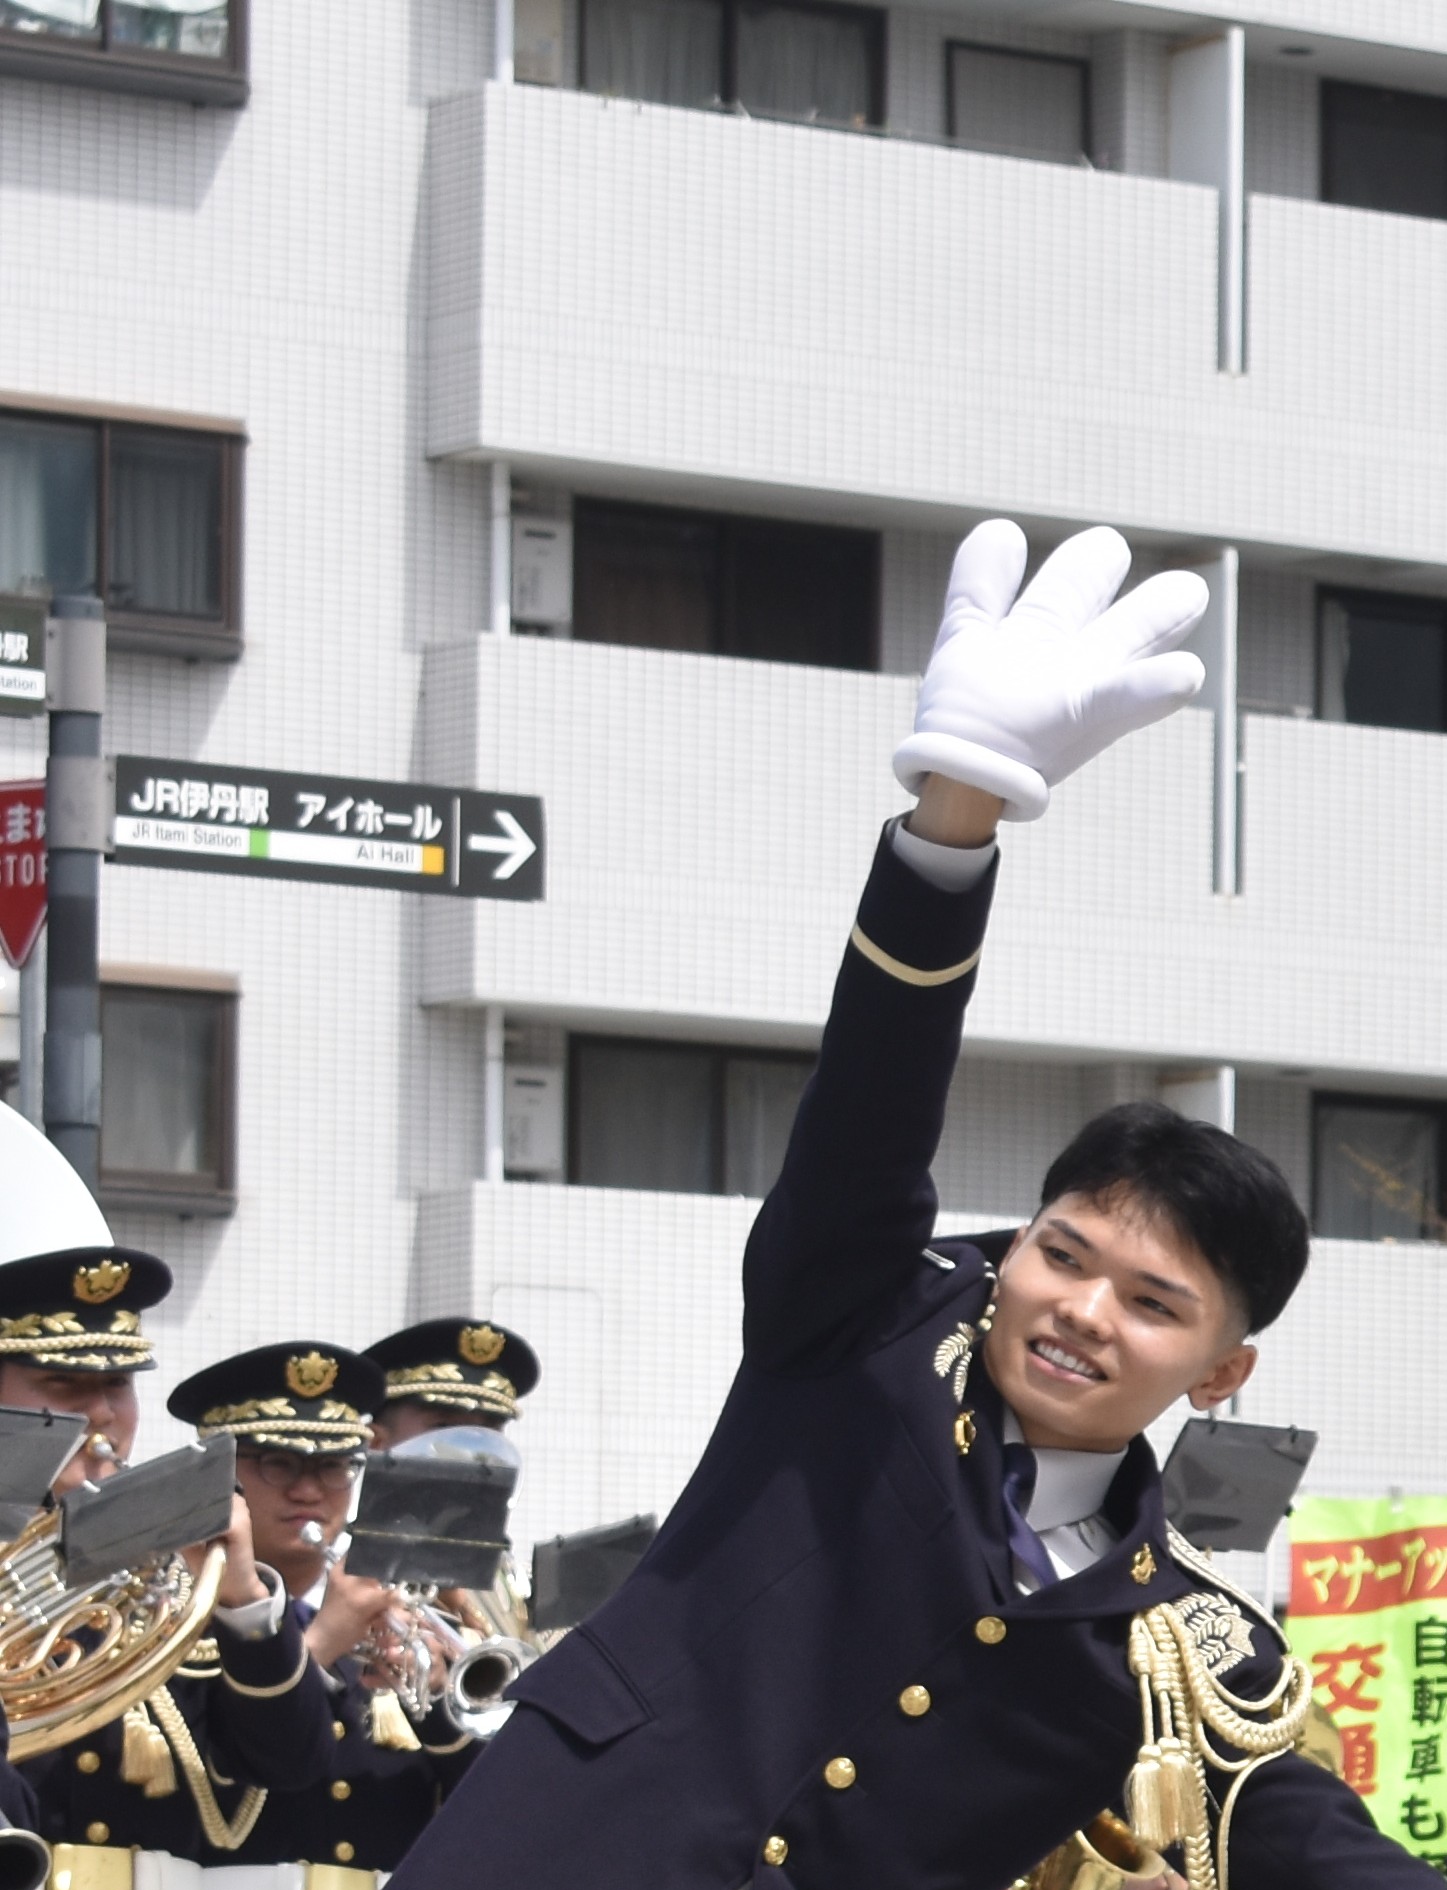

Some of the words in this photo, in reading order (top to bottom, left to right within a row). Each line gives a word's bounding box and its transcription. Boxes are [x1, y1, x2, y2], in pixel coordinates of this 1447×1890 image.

[130, 778, 269, 826] JR伊丹駅
[297, 792, 442, 841] アイホール
[132, 822, 151, 839] JR
[193, 829, 243, 850] Station
[380, 846, 415, 865] Hall
